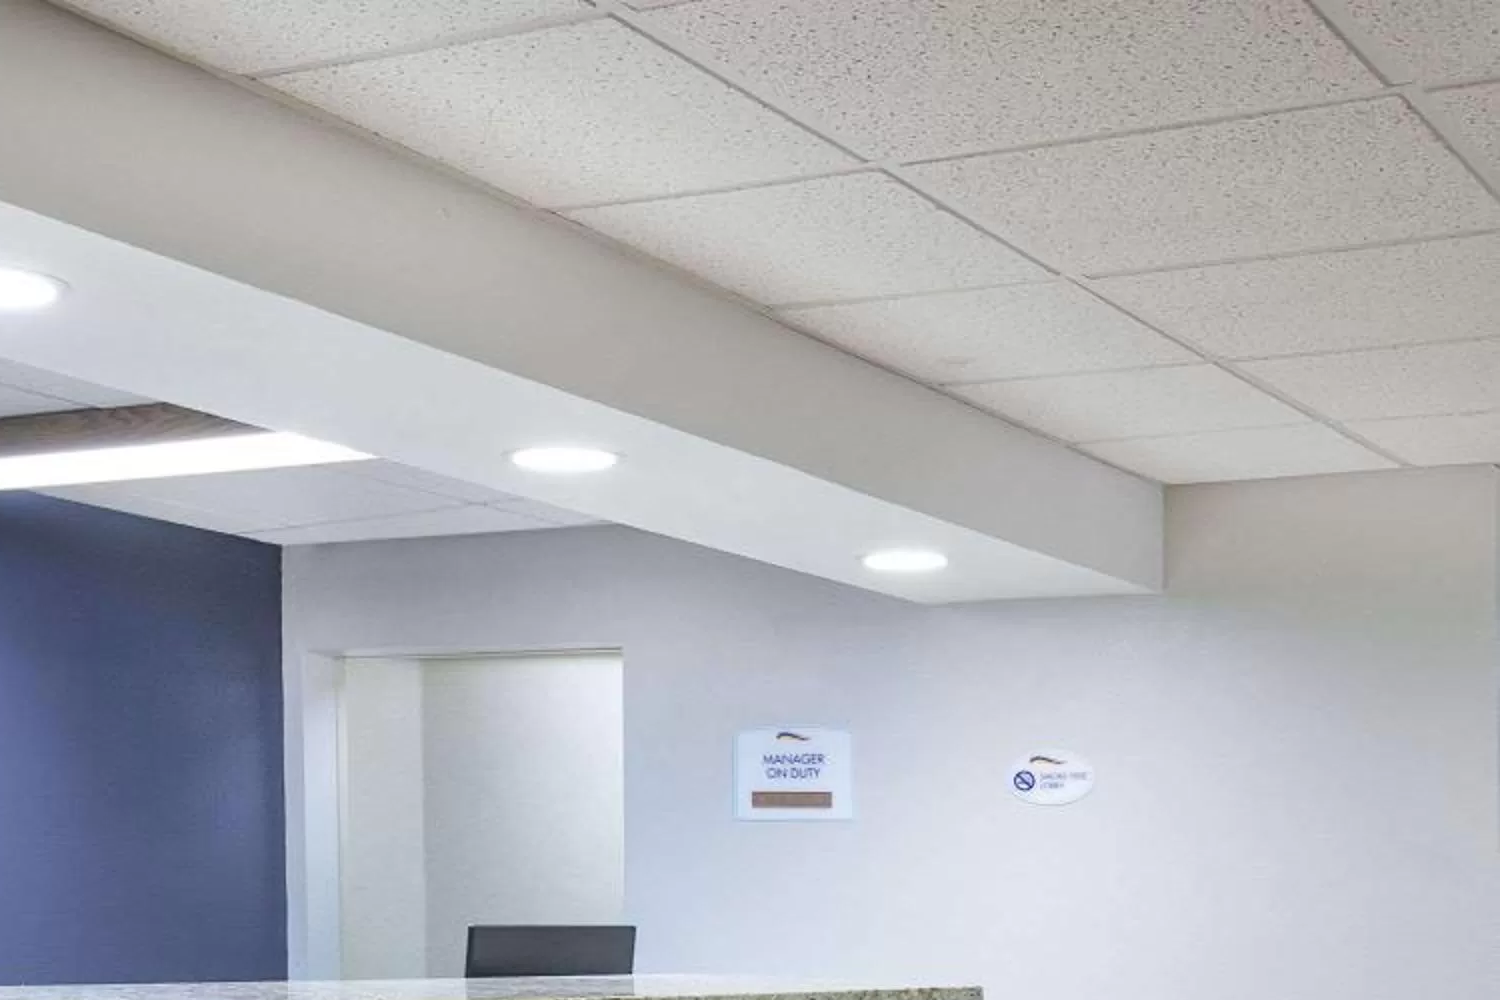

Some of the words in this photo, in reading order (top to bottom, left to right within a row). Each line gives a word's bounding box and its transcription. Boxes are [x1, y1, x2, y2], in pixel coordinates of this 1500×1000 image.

[763, 753, 825, 765] MANAGER
[766, 767, 788, 779] ON
[791, 767, 820, 779] DUTY
